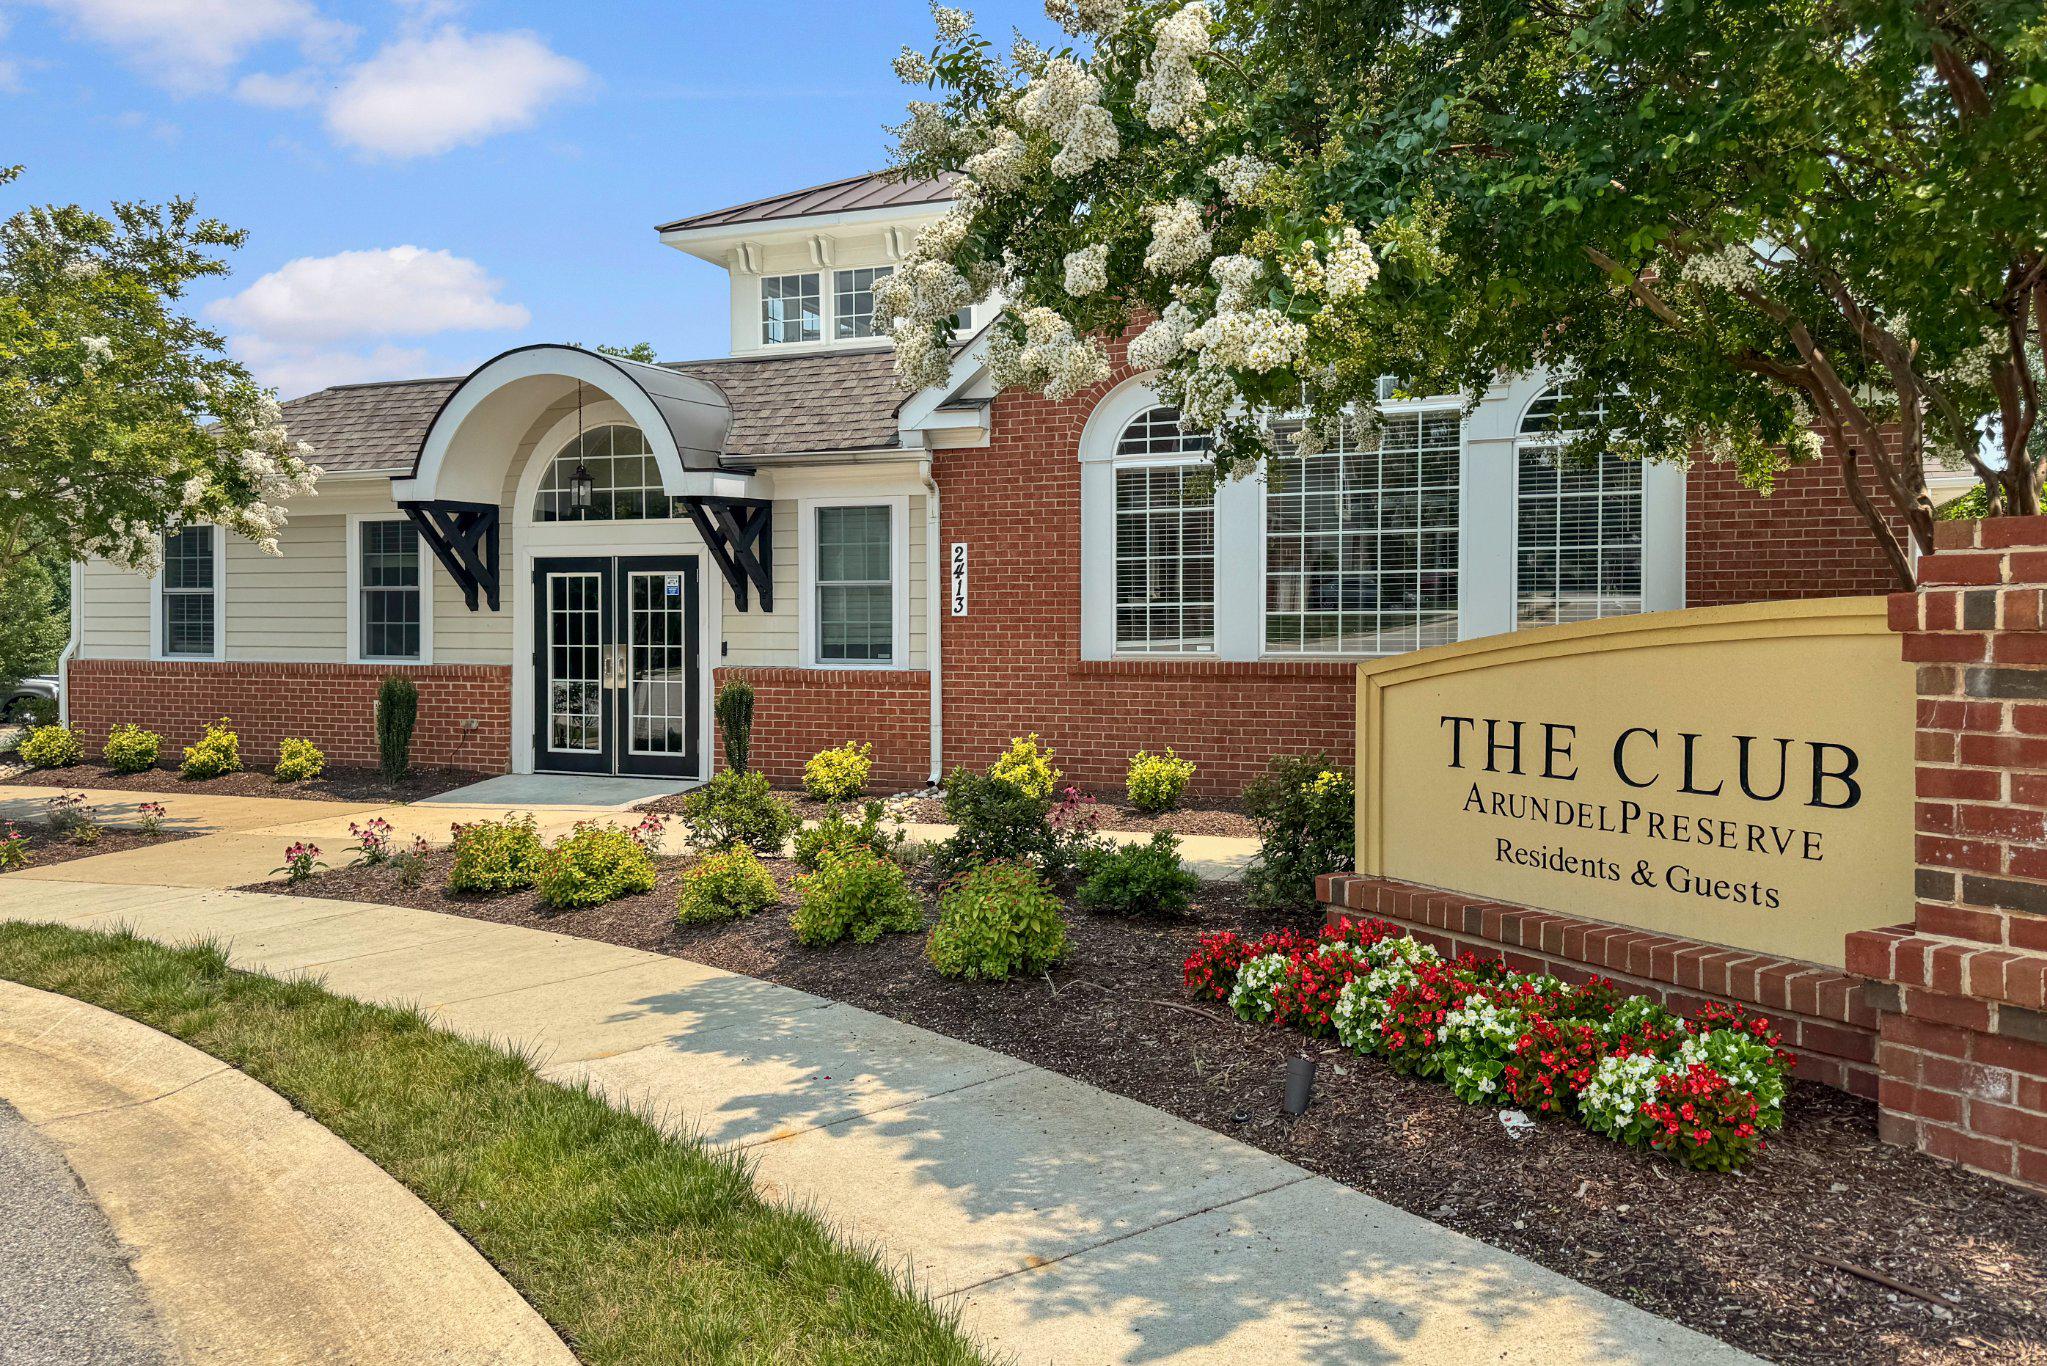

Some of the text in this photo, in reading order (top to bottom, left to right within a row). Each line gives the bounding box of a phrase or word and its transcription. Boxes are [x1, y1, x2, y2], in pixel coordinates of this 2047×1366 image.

[953, 546, 965, 613] 2413
[1440, 715, 1863, 810] THE CLUB
[1495, 837, 1781, 909] Residents & Guests
